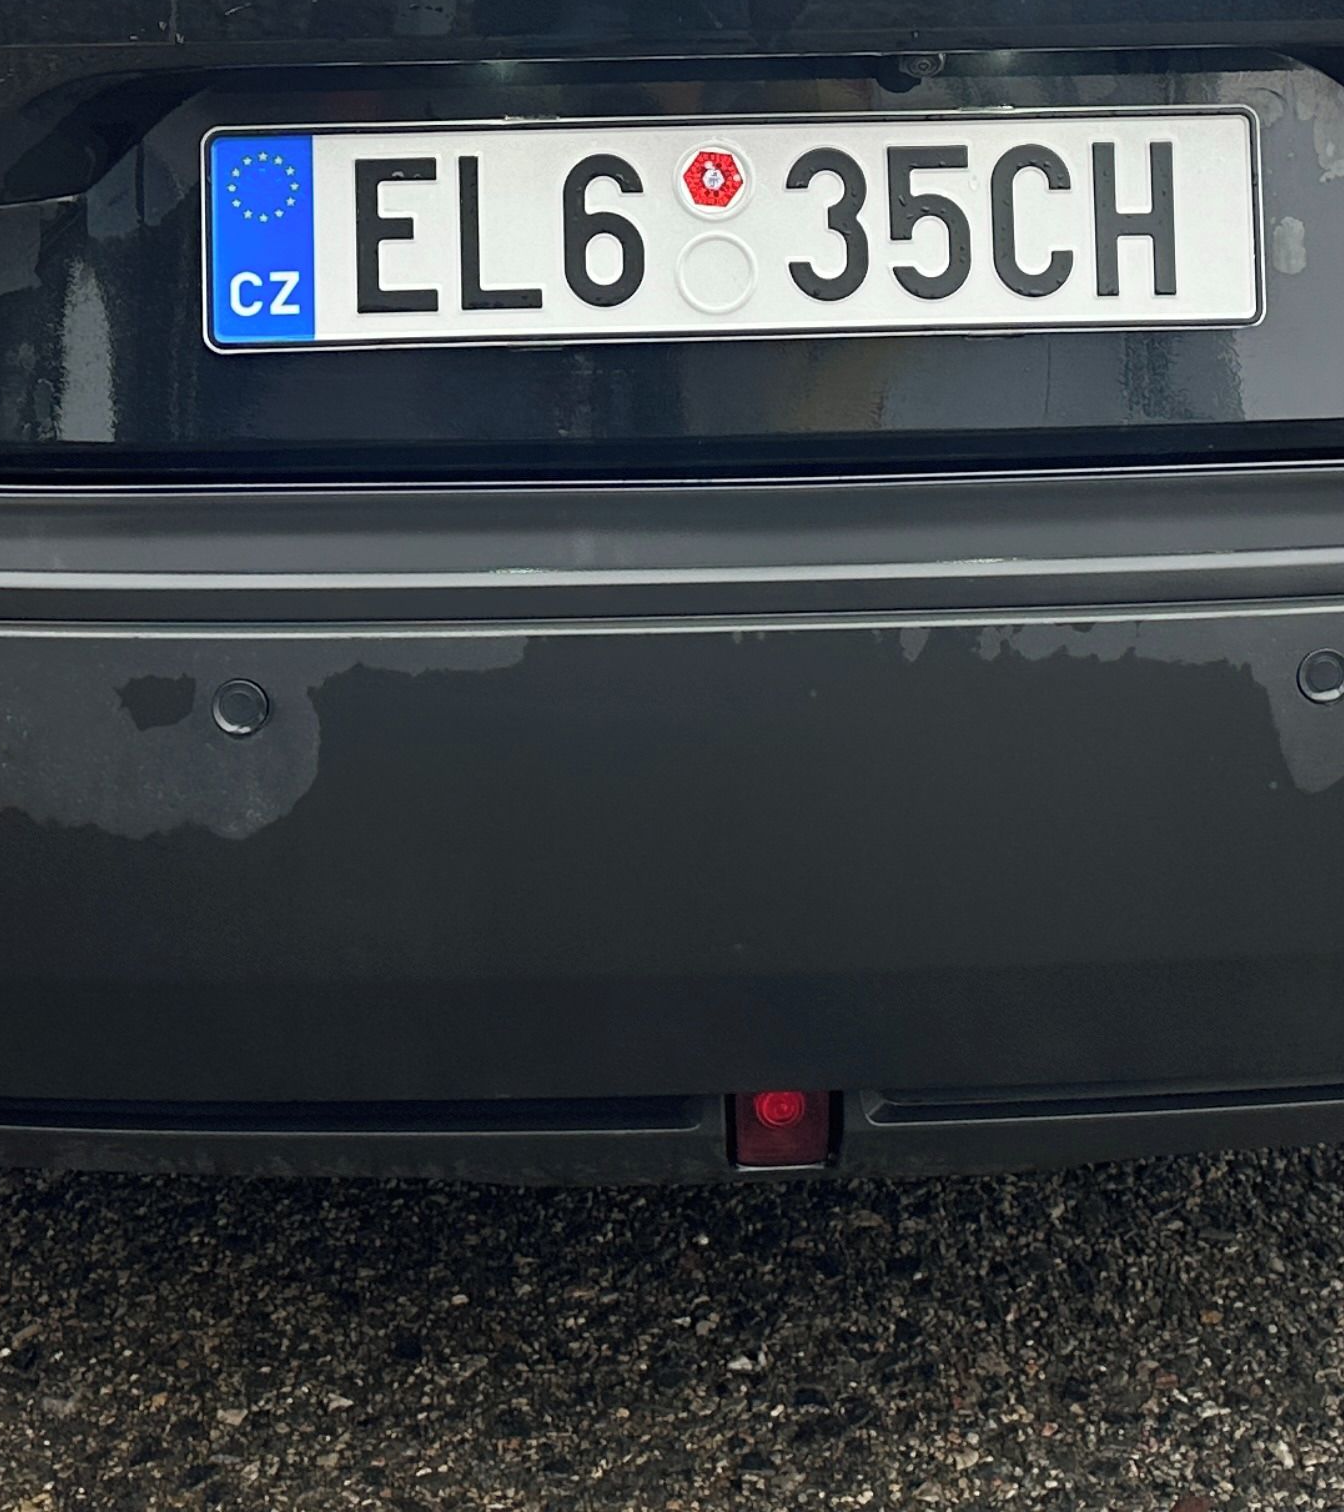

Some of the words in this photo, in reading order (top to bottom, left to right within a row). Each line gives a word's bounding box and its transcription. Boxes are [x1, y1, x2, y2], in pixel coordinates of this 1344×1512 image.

[355, 153, 646, 314] EL6
[785, 141, 1177, 302] 35CH
[230, 271, 301, 317] CZ
